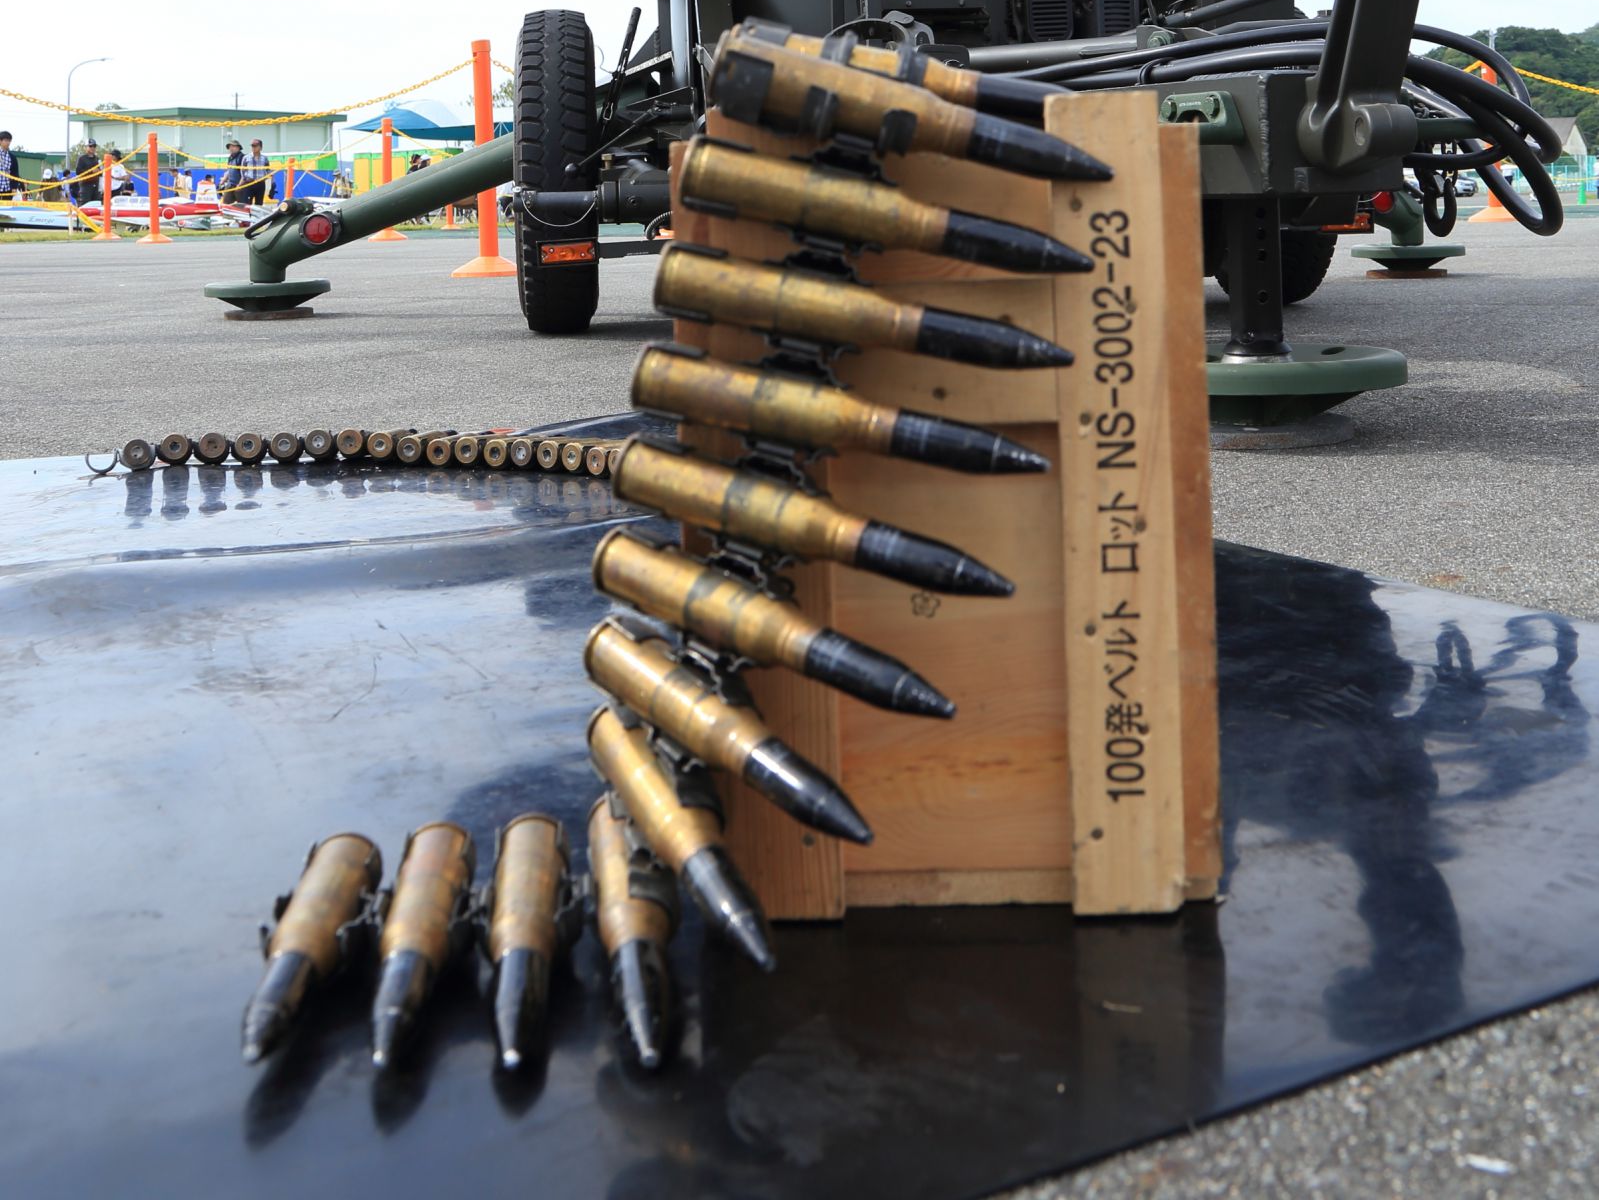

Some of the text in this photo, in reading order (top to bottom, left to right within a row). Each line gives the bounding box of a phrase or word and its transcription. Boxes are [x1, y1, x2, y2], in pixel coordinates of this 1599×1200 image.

[1089, 210, 1146, 802] 100発ベルト ロット NS-3002-23
